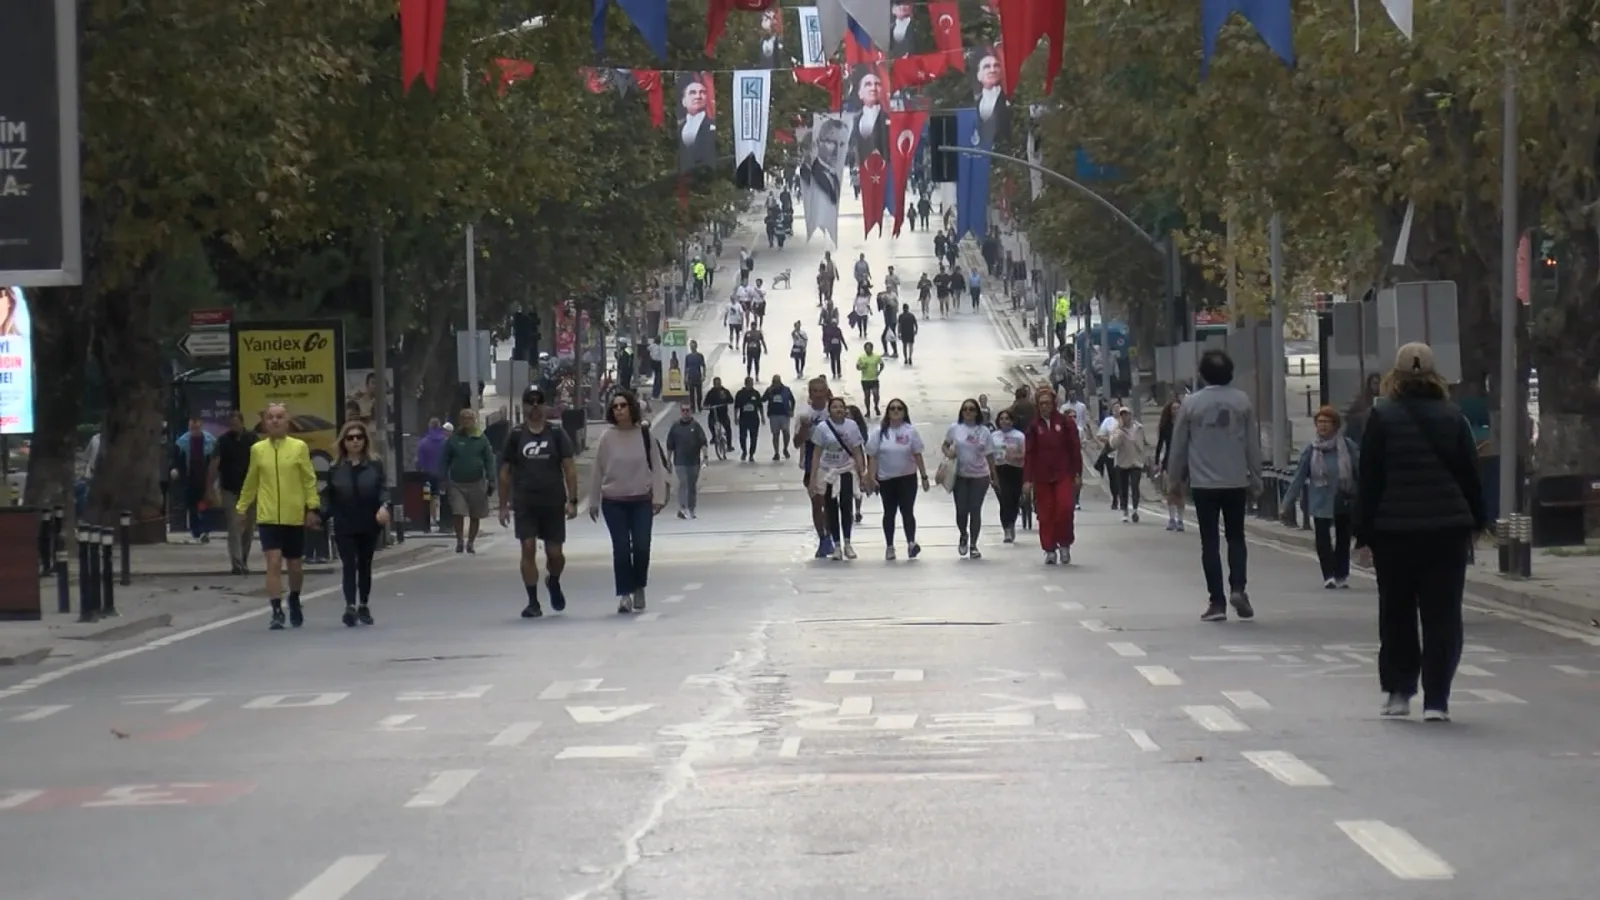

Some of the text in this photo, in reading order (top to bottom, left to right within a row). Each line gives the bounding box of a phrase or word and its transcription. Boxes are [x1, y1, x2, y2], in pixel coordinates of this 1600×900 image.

[746, 81, 759, 96] K
[242, 332, 328, 352] Yandex Go
[263, 356, 307, 371] Taksini
[289, 373, 324, 385] varan
